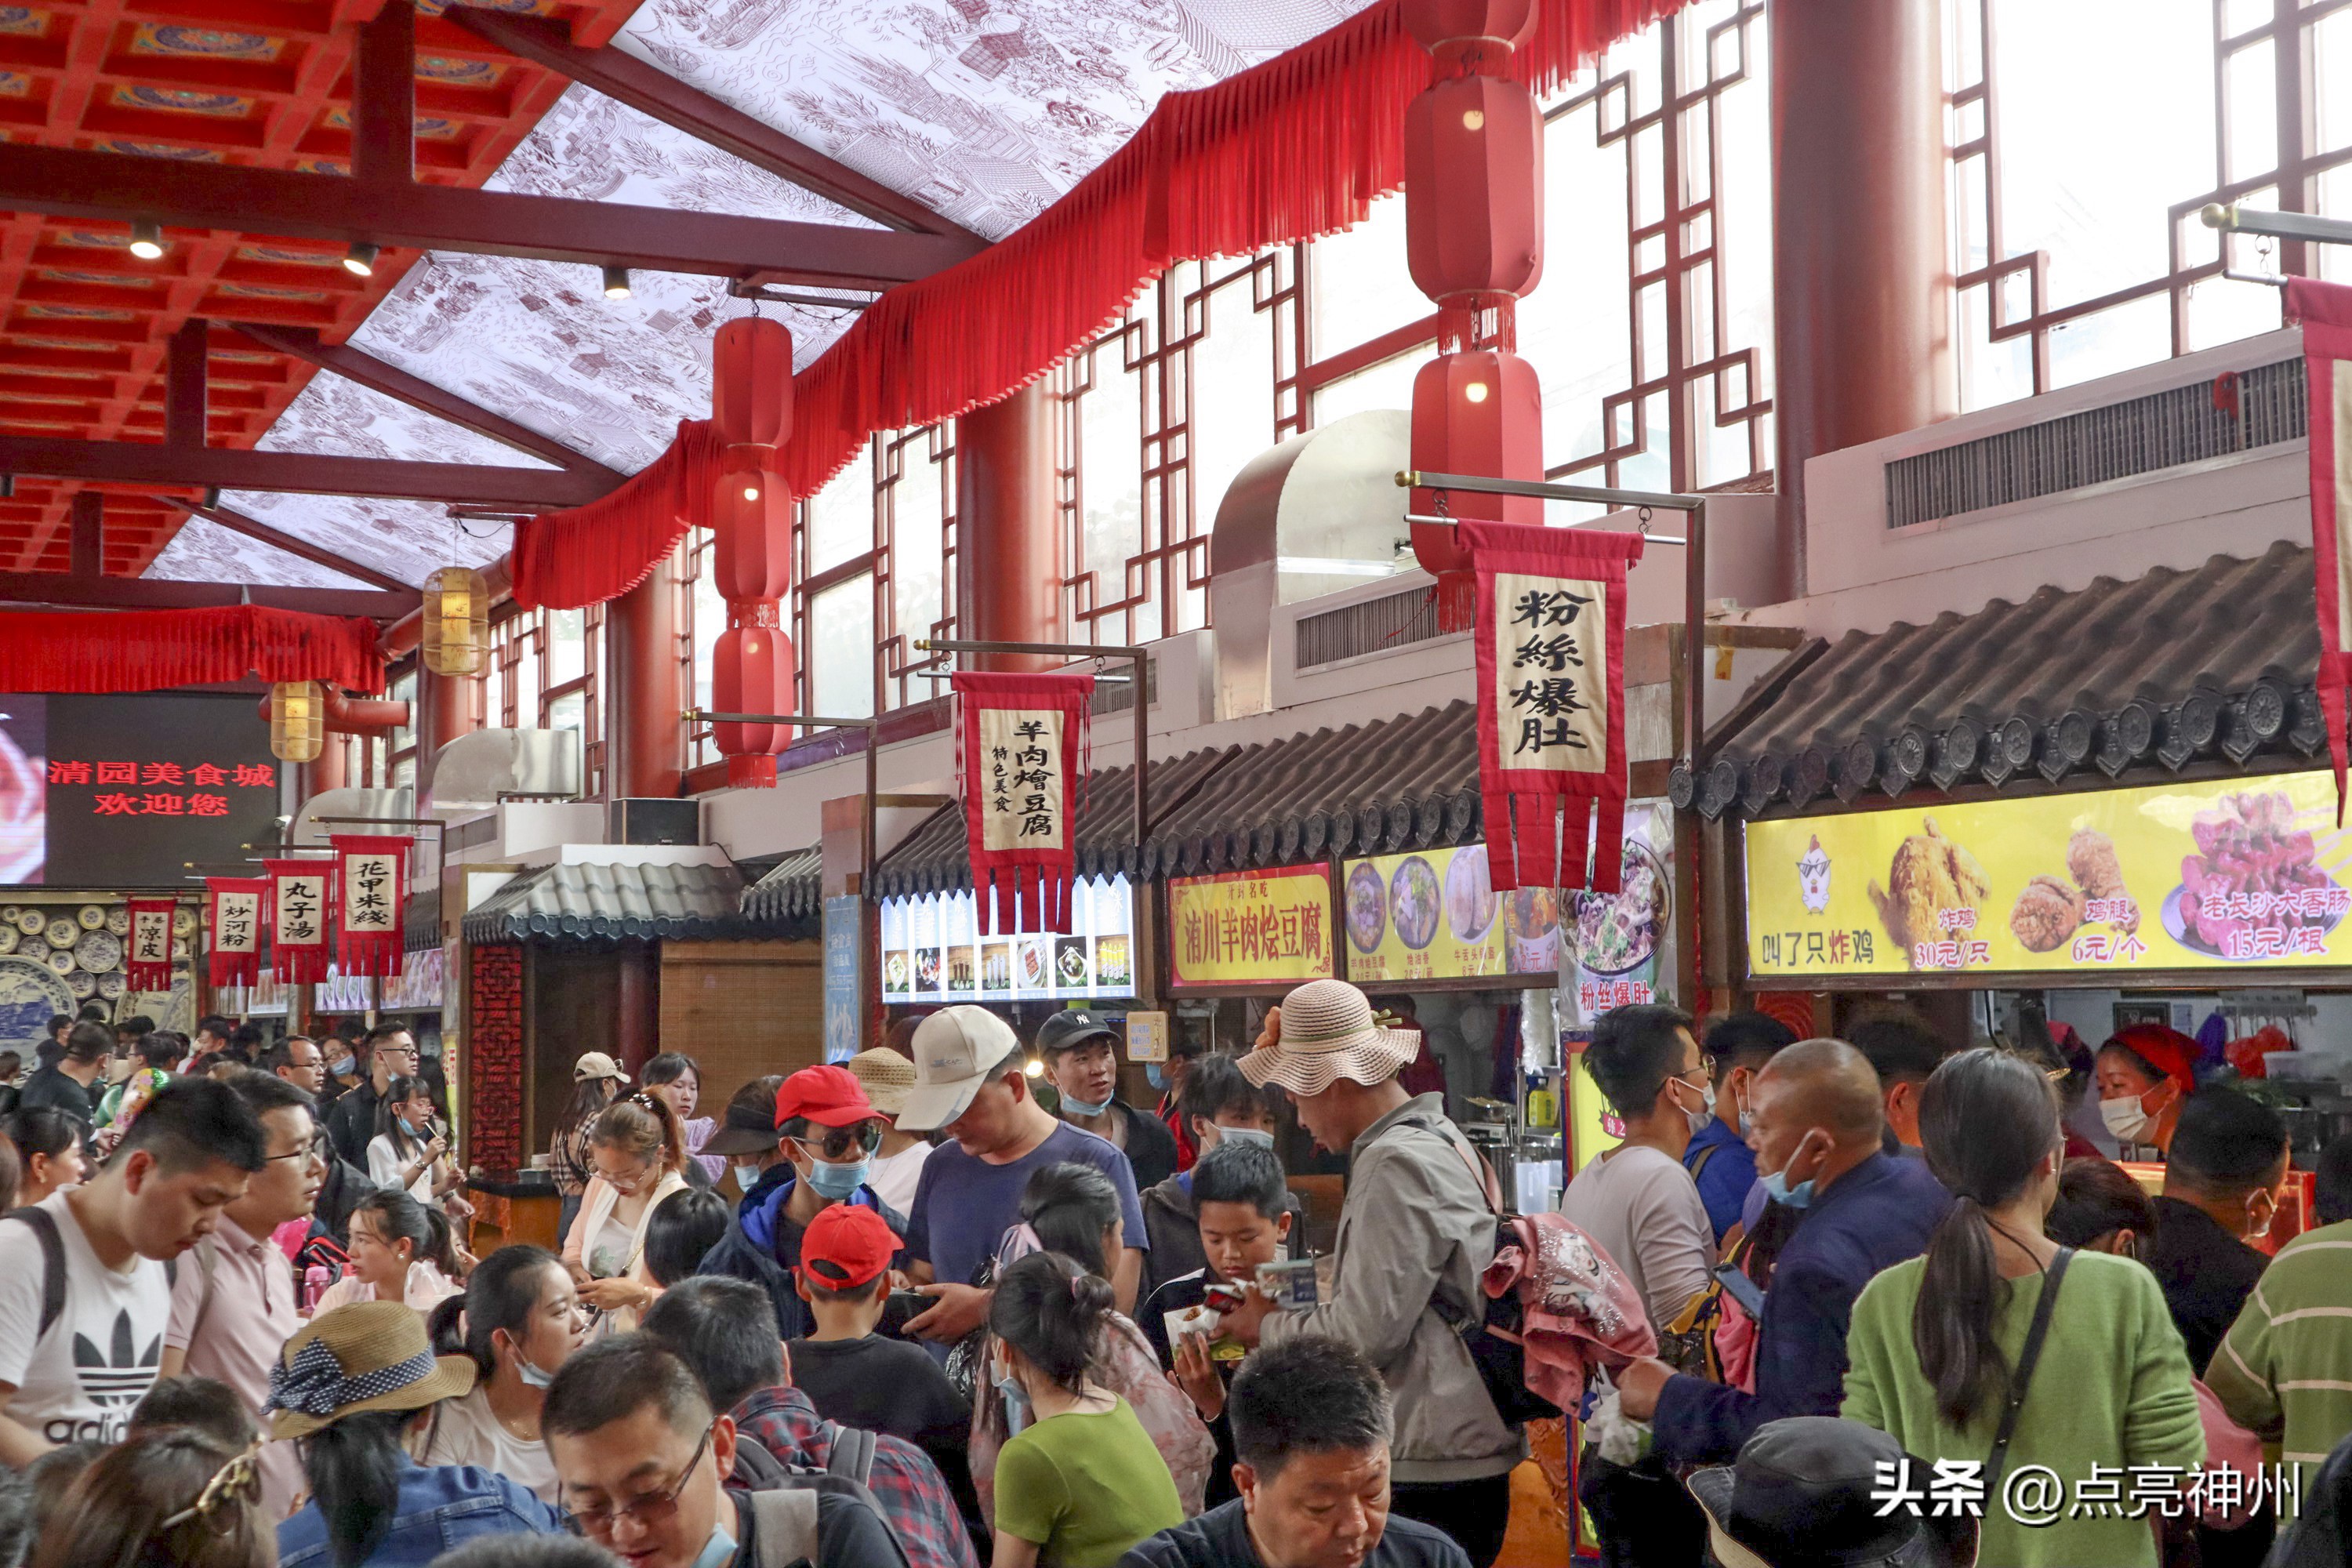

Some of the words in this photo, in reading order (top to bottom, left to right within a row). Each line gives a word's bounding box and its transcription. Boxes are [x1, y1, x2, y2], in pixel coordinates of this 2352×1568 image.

[1509, 590, 1595, 755] 粉絲爆肚
[48, 760, 275, 787] 清园美食城
[992, 746, 1012, 812] 特色美食
[1014, 720, 1055, 837] 羊肉燴豆腐
[93, 792, 229, 816] 欢迎您
[1228, 880, 1269, 900] 开封名吃
[2202, 888, 2351, 920] 老长沙大香肠
[284, 882, 317, 938] 丸子湯
[1938, 909, 1976, 930] 炸鸡
[2085, 898, 2132, 922] 鸡腿
[220, 906, 252, 946] 炒河粉
[1185, 901, 1322, 965] 洧川羊肉烩豆腐
[1762, 930, 1874, 967] 叫了只炸鸡
[1916, 941, 1990, 967] 30元/只
[2072, 936, 2147, 963] 6元/个
[2228, 927, 2328, 958] 15元/根
[1580, 980, 1650, 1011] 粉丝爆肚
